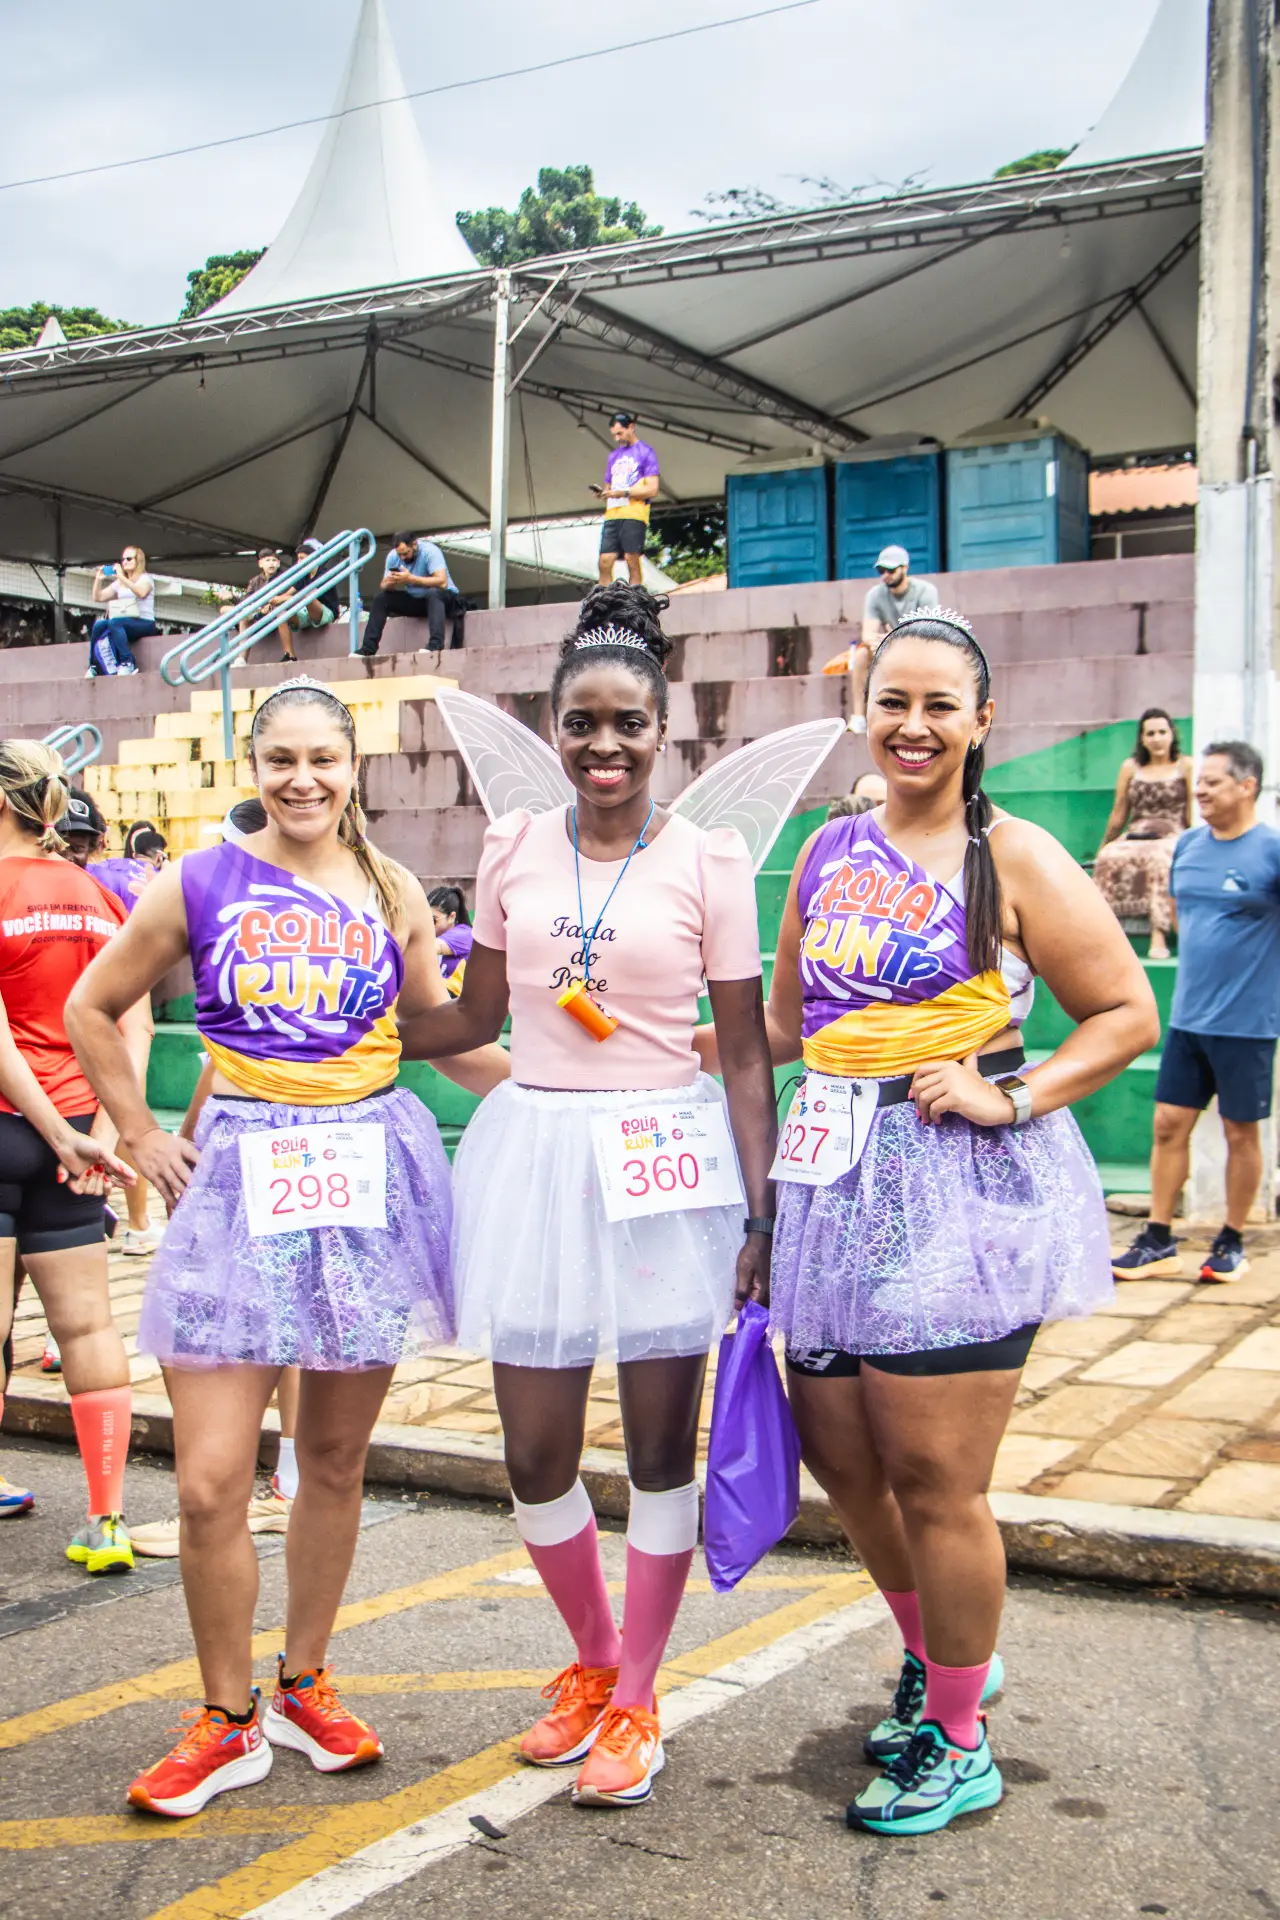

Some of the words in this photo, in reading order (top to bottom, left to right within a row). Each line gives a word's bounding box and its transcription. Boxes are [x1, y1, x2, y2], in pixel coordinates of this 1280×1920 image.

[27, 903, 48, 913] SIGA
[50, 903, 60, 911] EM
[2, 911, 43, 937] VOCÊ
[50, 914, 83, 931] MAIS
[550, 916, 617, 942] Fada
[570, 942, 601, 966] do
[780, 1123, 830, 1164] 327
[622, 1152, 700, 1197] 360
[269, 1172, 351, 1216] 298
